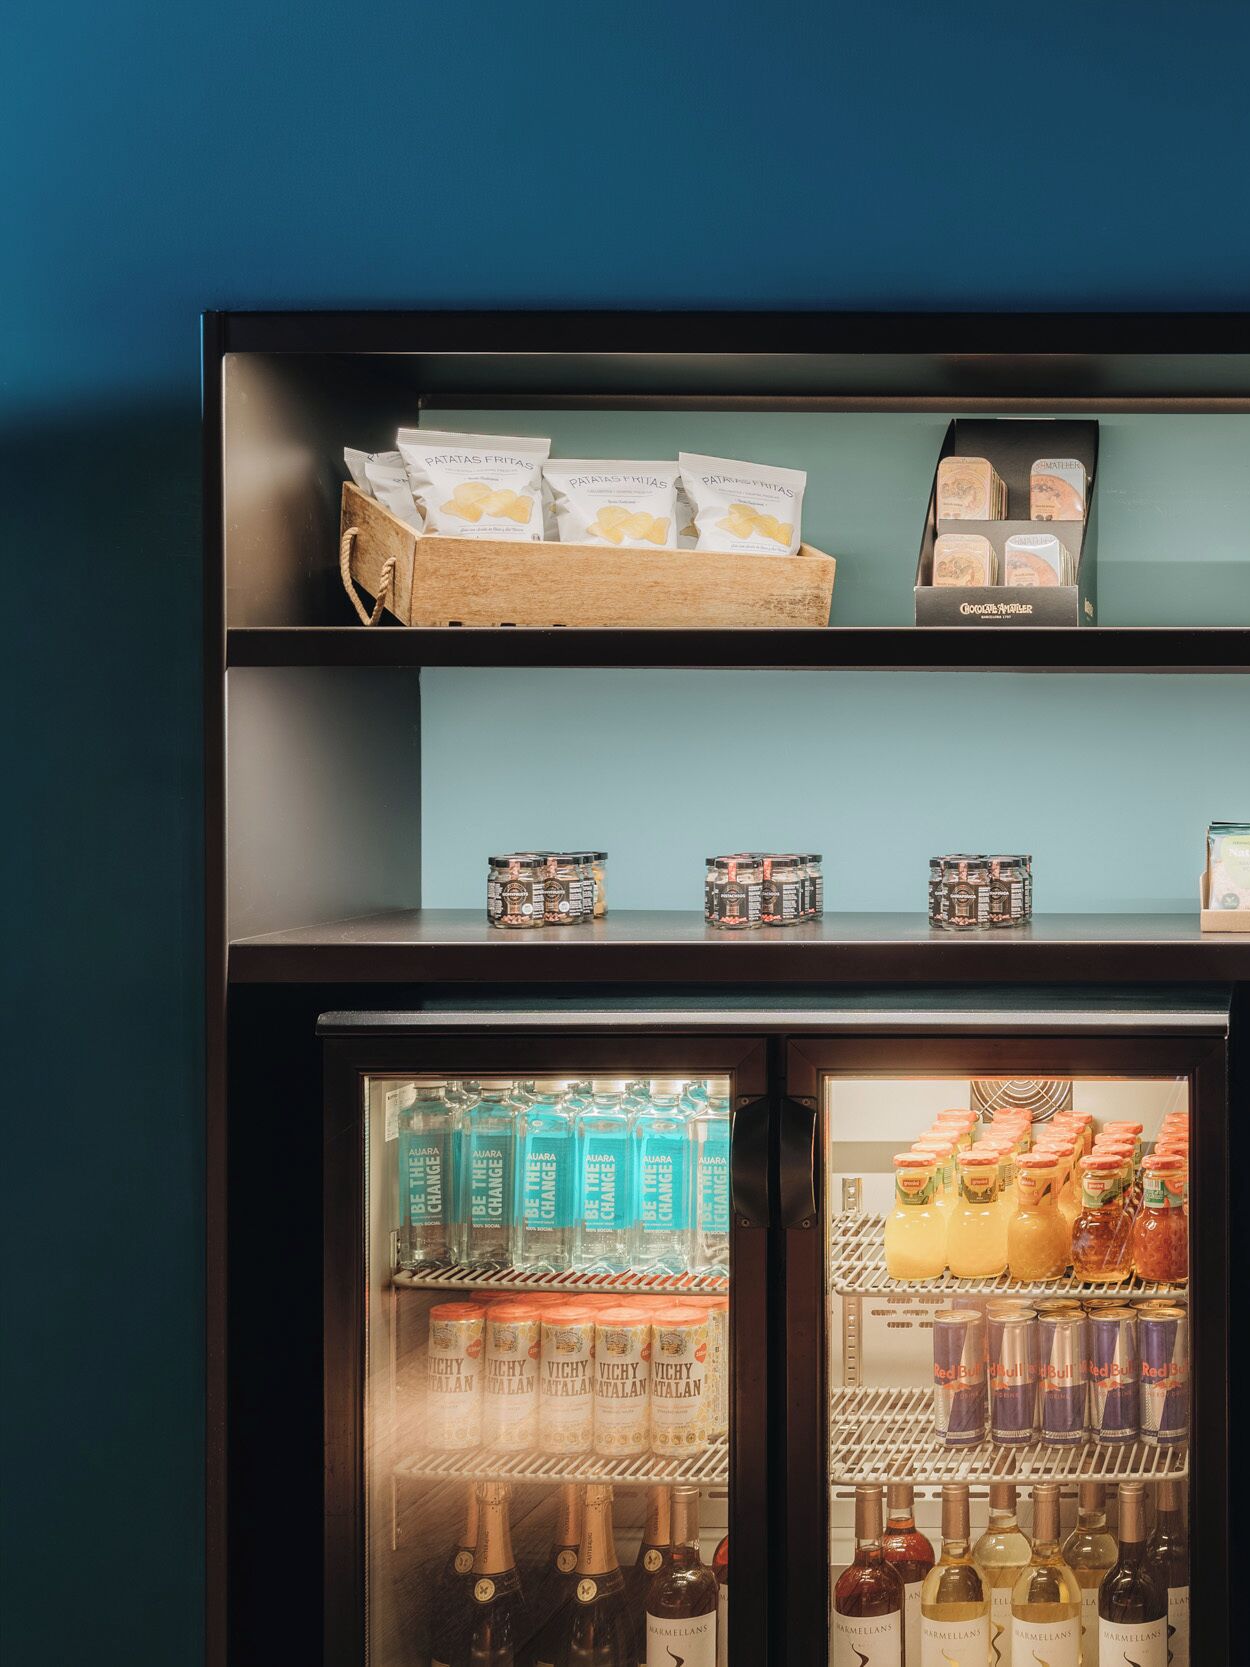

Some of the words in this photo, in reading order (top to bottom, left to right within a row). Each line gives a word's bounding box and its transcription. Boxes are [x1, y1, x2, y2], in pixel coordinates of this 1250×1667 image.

[425, 455, 482, 467] PATATAS
[485, 455, 534, 470] FRITAS
[569, 475, 621, 488] PATATAS
[408, 1147, 440, 1156] AUARA
[472, 1150, 502, 1158] AUARA
[526, 1153, 556, 1161] AUARA
[585, 1154, 615, 1162] AUARA
[642, 1155, 672, 1163] AUARA
[409, 1157, 424, 1188] THE
[472, 1160, 487, 1189] THE
[525, 1163, 541, 1191] THE
[584, 1163, 600, 1192] THE
[641, 1164, 658, 1193] THE
[426, 1156, 441, 1213] CHANGE
[488, 1159, 503, 1216] CHANGE
[541, 1162, 556, 1219] CHANGE
[601, 1163, 615, 1220] CHANGE
[658, 1165, 673, 1222] CHANGE
[410, 1193, 425, 1214] BE
[471, 1195, 486, 1215] BE
[524, 1196, 540, 1218] BE
[584, 1198, 599, 1220] BE
[641, 1199, 657, 1221] BE
[488, 1358, 527, 1377] VICHY
[548, 1360, 588, 1378] VICHY
[599, 1362, 639, 1380] VICHY
[655, 1362, 693, 1380] VICHY
[933, 1363, 955, 1379] Red
[1047, 1363, 1073, 1379] Bull
[1142, 1360, 1167, 1377] Red
[596, 1378, 647, 1399] ATALAN
[652, 1378, 701, 1399] ATALAN
[1103, 1631, 1162, 1643] MARMELLANS
